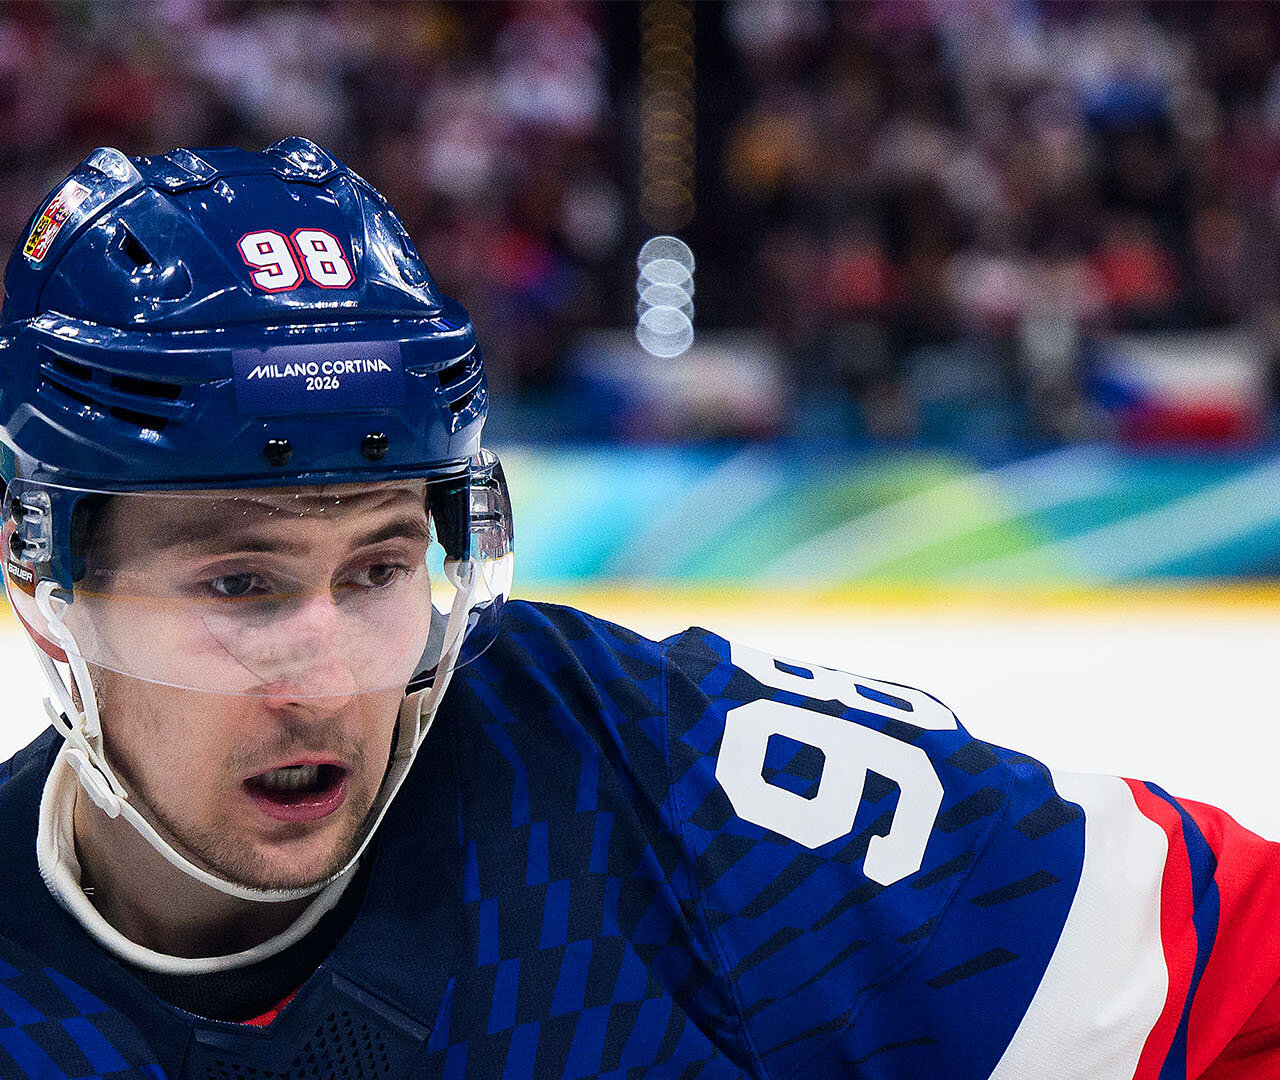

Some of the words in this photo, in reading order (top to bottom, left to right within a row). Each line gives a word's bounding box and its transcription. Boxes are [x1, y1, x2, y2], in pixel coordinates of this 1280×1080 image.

[237, 228, 355, 292] 98
[247, 363, 319, 380] MILANO
[321, 359, 392, 375] CORTINA
[306, 376, 340, 390] 2026
